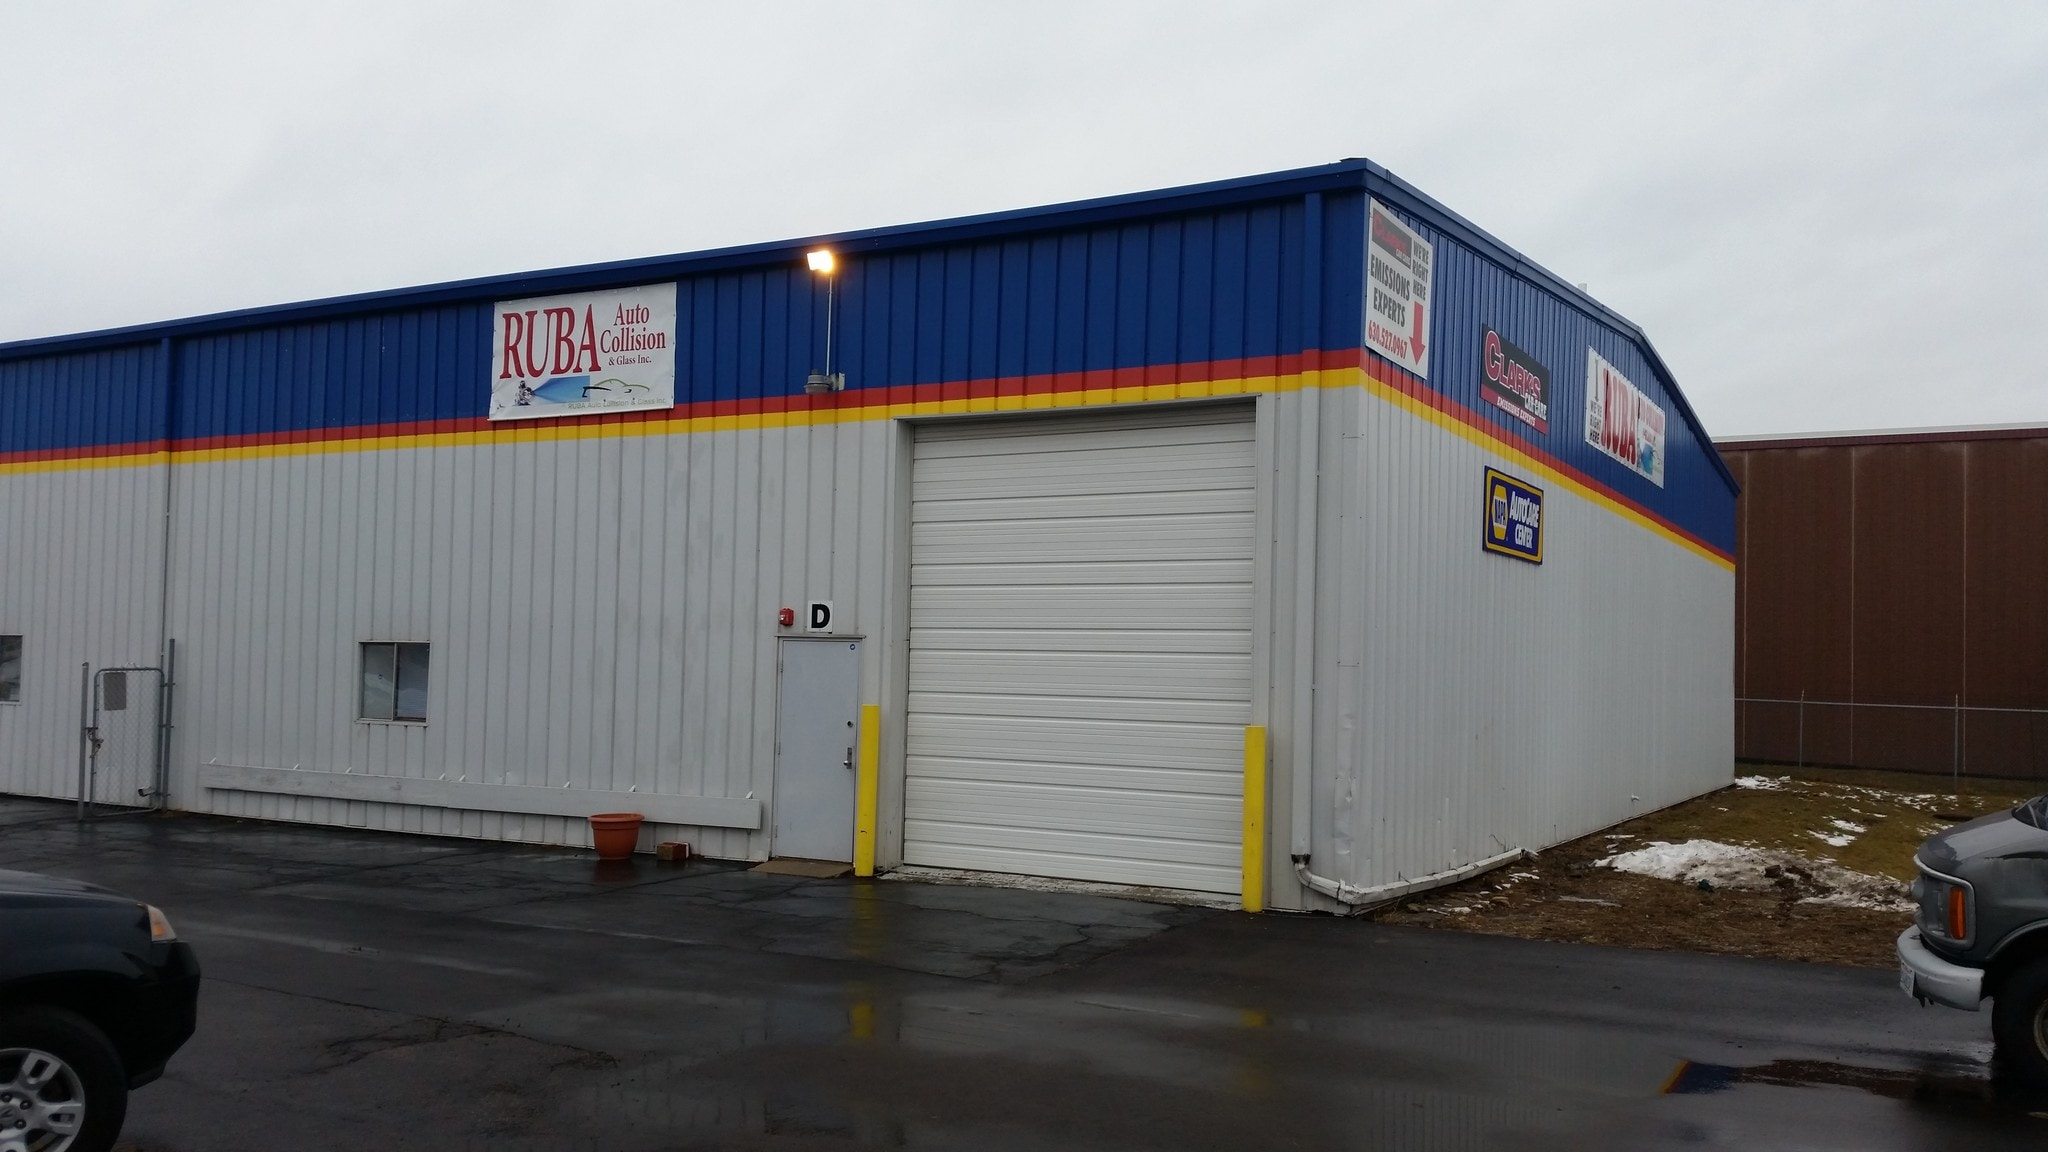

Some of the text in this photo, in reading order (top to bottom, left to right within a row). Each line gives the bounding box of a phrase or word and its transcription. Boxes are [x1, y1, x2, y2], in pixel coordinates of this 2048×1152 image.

[1371, 253, 1410, 301] EMISSIONS
[1412, 259, 1428, 283] RIGHT
[1412, 279, 1427, 301] HERE
[613, 302, 650, 326] Auto
[1373, 287, 1406, 327] EXPERTS
[500, 303, 602, 379] RUBA
[600, 326, 667, 354] Collision
[1368, 319, 1408, 359] 630.527.0967
[608, 353, 652, 366] & Glass Inc.
[1601, 367, 1637, 466] RUBA
[1515, 523, 1533, 549] CENTER
[811, 603, 831, 629] D
